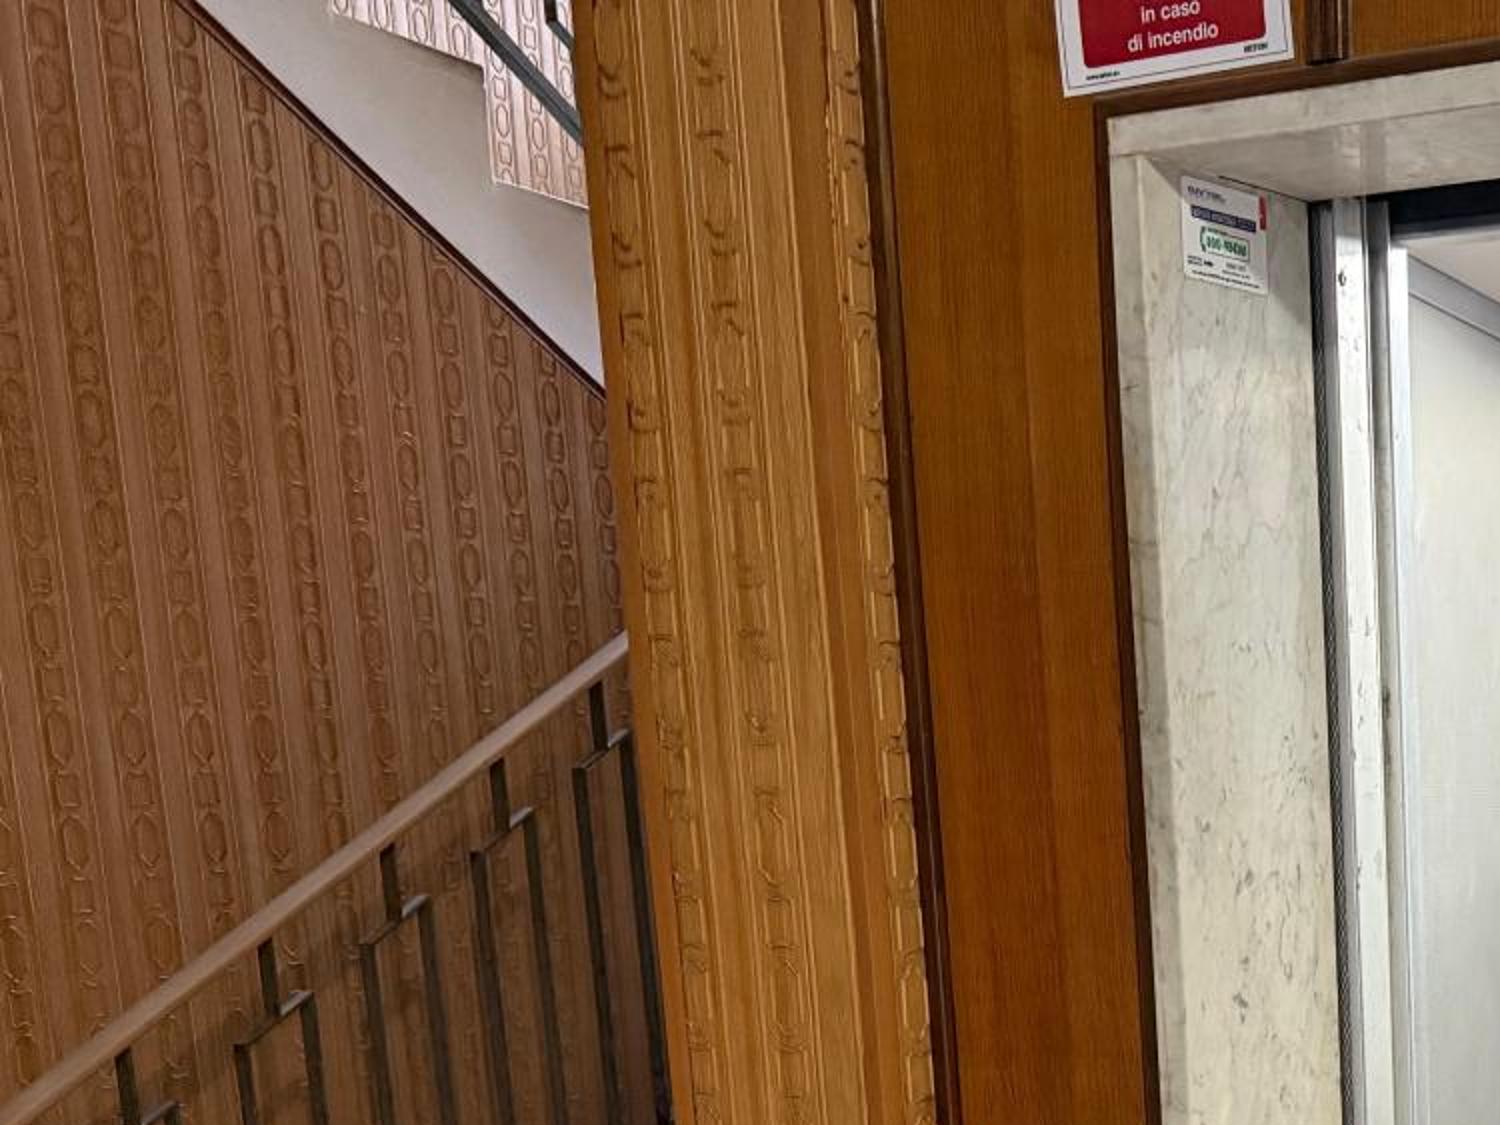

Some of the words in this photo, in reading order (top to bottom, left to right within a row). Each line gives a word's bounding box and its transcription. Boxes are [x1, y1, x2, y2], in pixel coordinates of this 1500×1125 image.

[1140, 6, 1156, 24] in
[1160, 0, 1201, 21] caso
[1127, 33, 1144, 53] di
[1147, 22, 1219, 49] incendio
